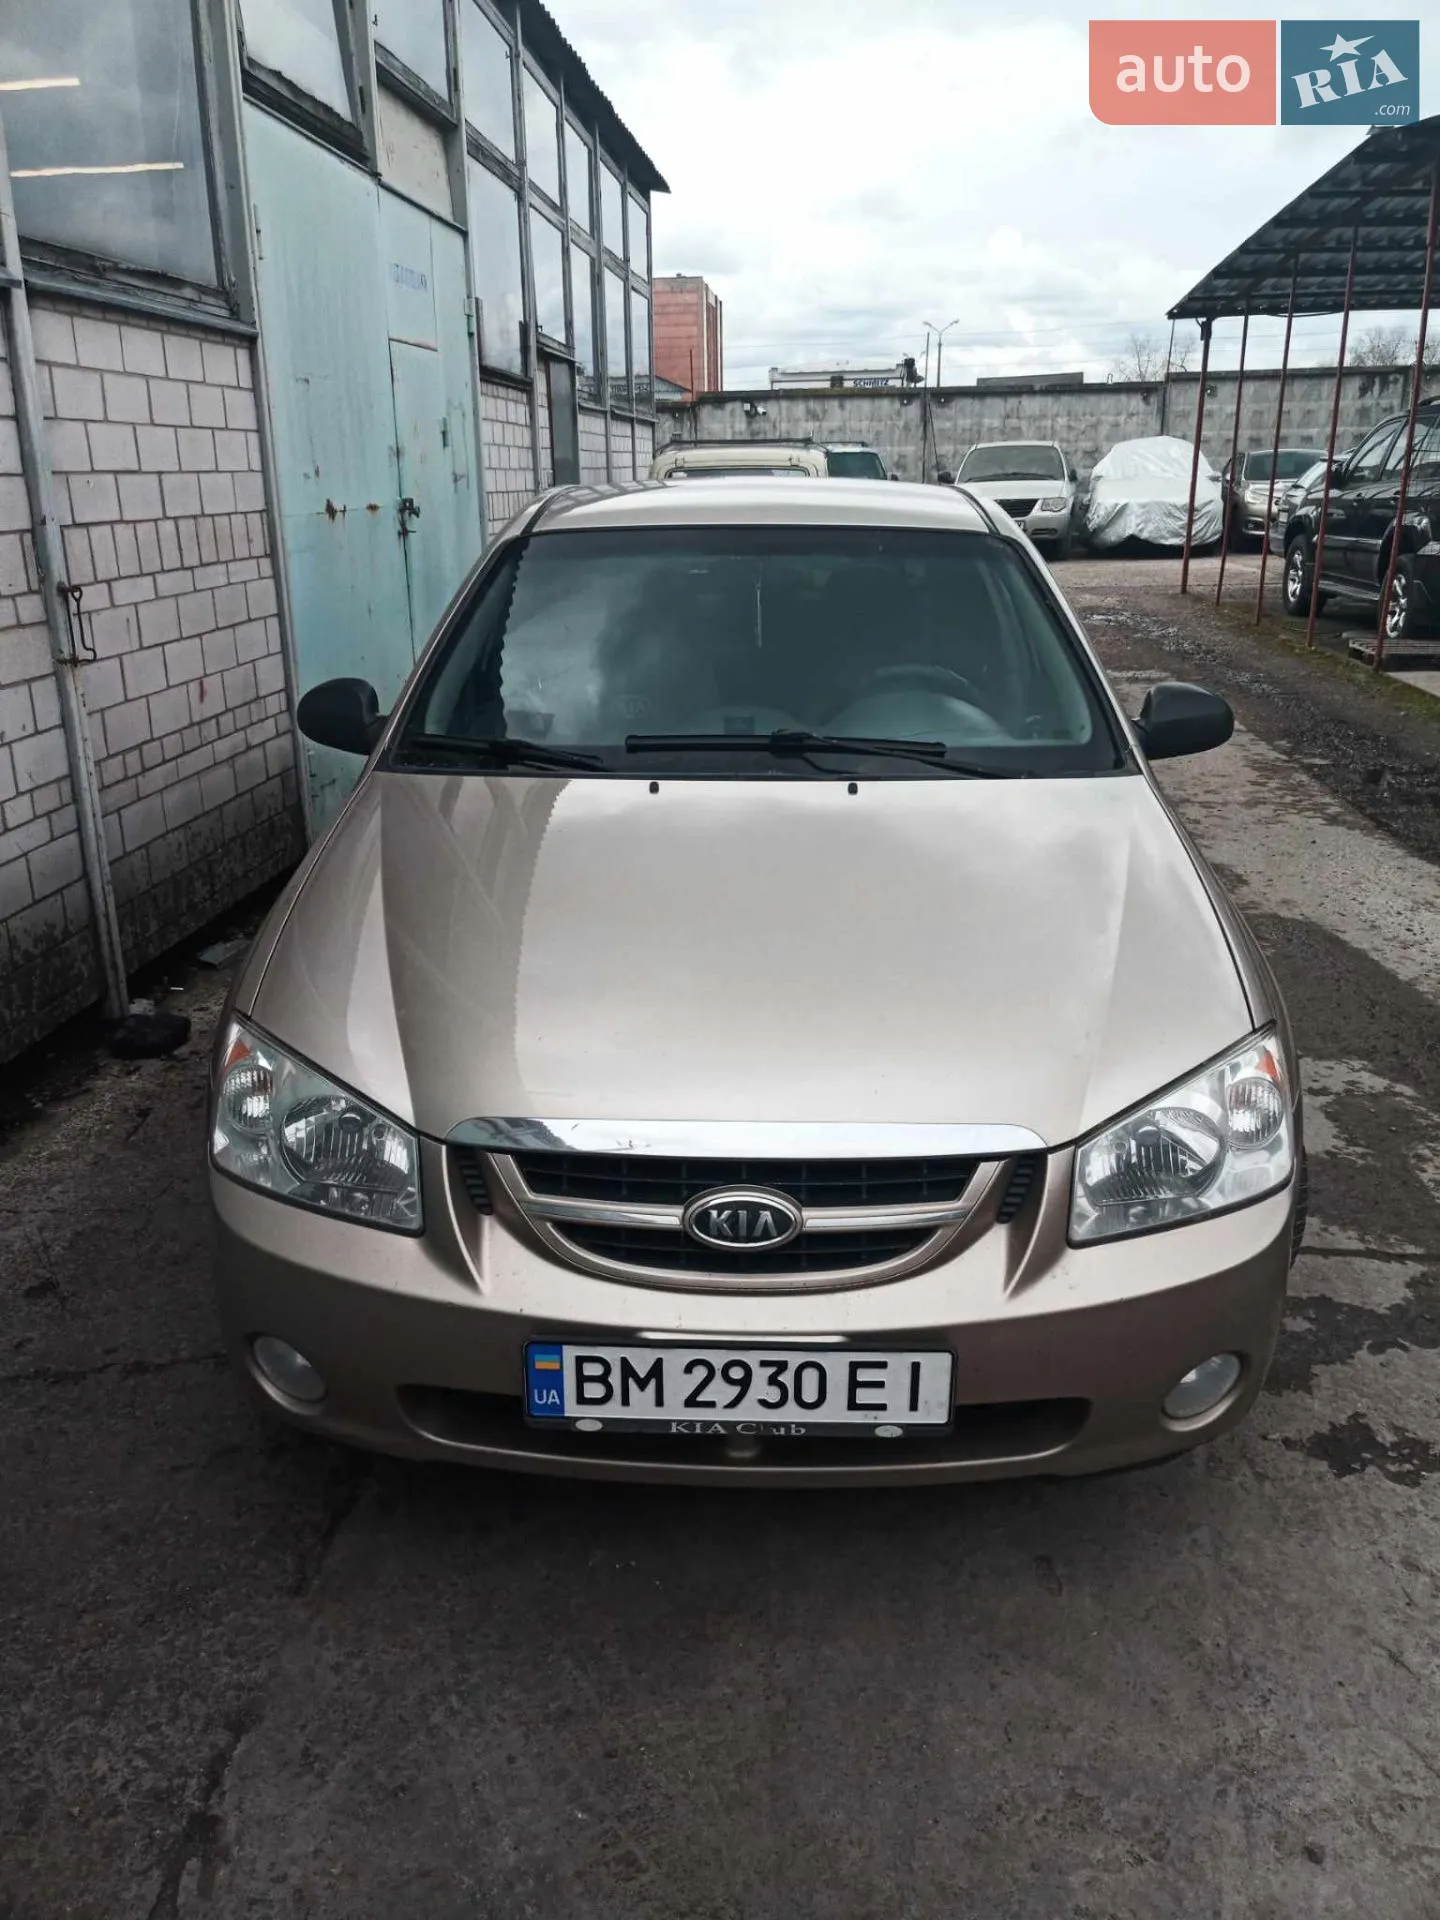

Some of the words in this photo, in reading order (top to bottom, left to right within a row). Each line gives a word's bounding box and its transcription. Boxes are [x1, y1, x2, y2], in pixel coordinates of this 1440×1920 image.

[709, 1209, 778, 1237] KIA
[575, 1355, 664, 1407] BM
[683, 1358, 827, 1410] 2930
[534, 1389, 561, 1405] UA
[669, 1422, 727, 1434] KIA
